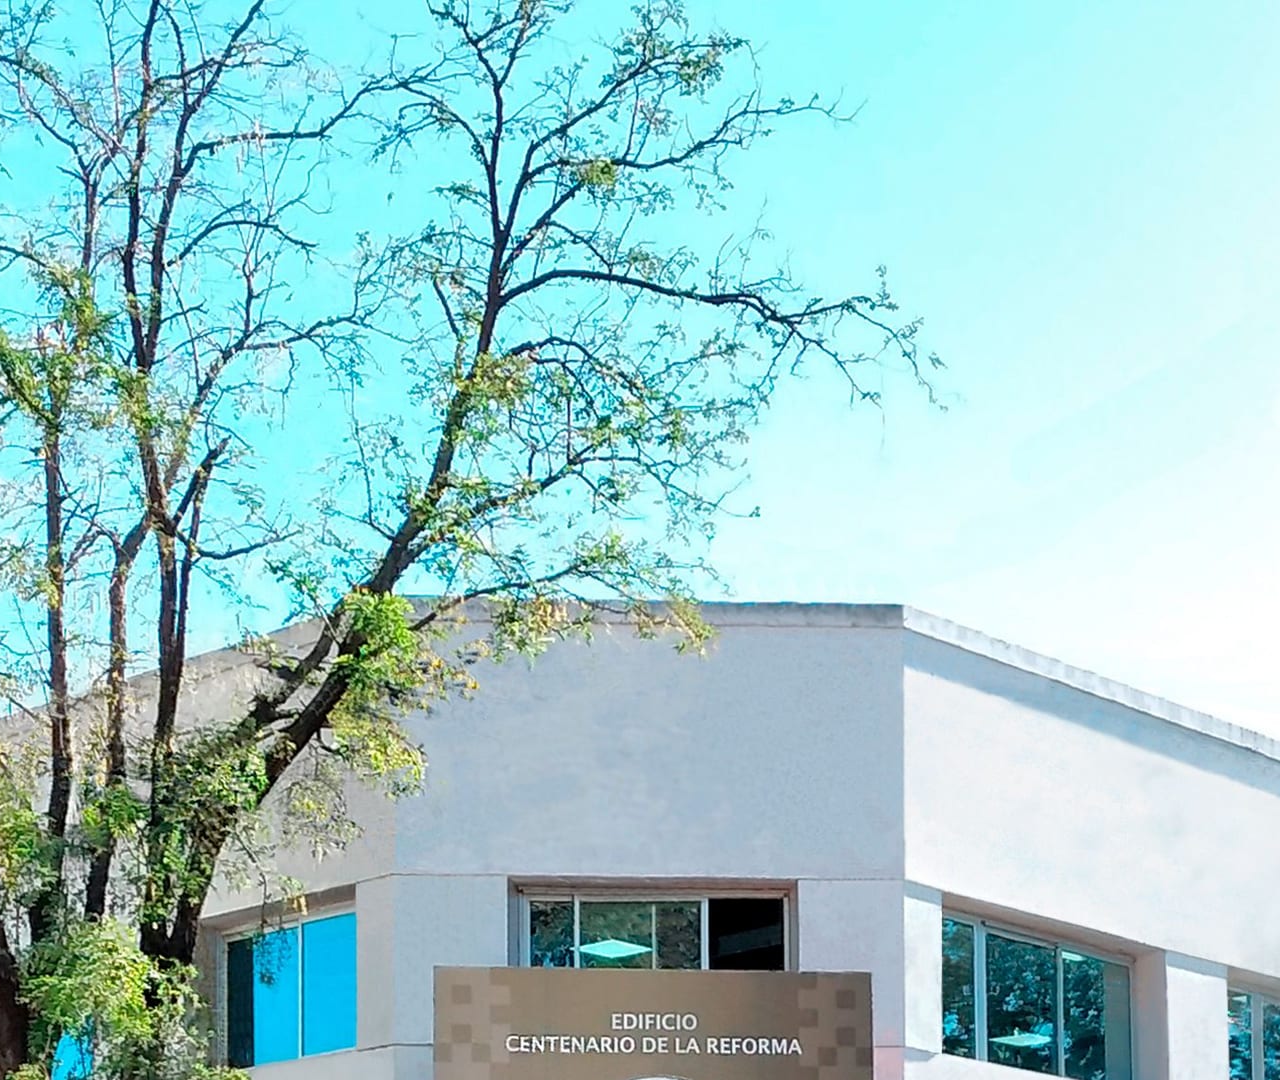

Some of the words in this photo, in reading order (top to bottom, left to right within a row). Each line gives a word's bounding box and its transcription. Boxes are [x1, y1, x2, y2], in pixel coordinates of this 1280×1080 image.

[610, 1013, 698, 1031] EDIFICIO
[505, 1034, 636, 1055] CENTENARIO
[642, 1036, 669, 1055] DE
[675, 1037, 700, 1055] LA
[706, 1037, 803, 1056] REFORMA
